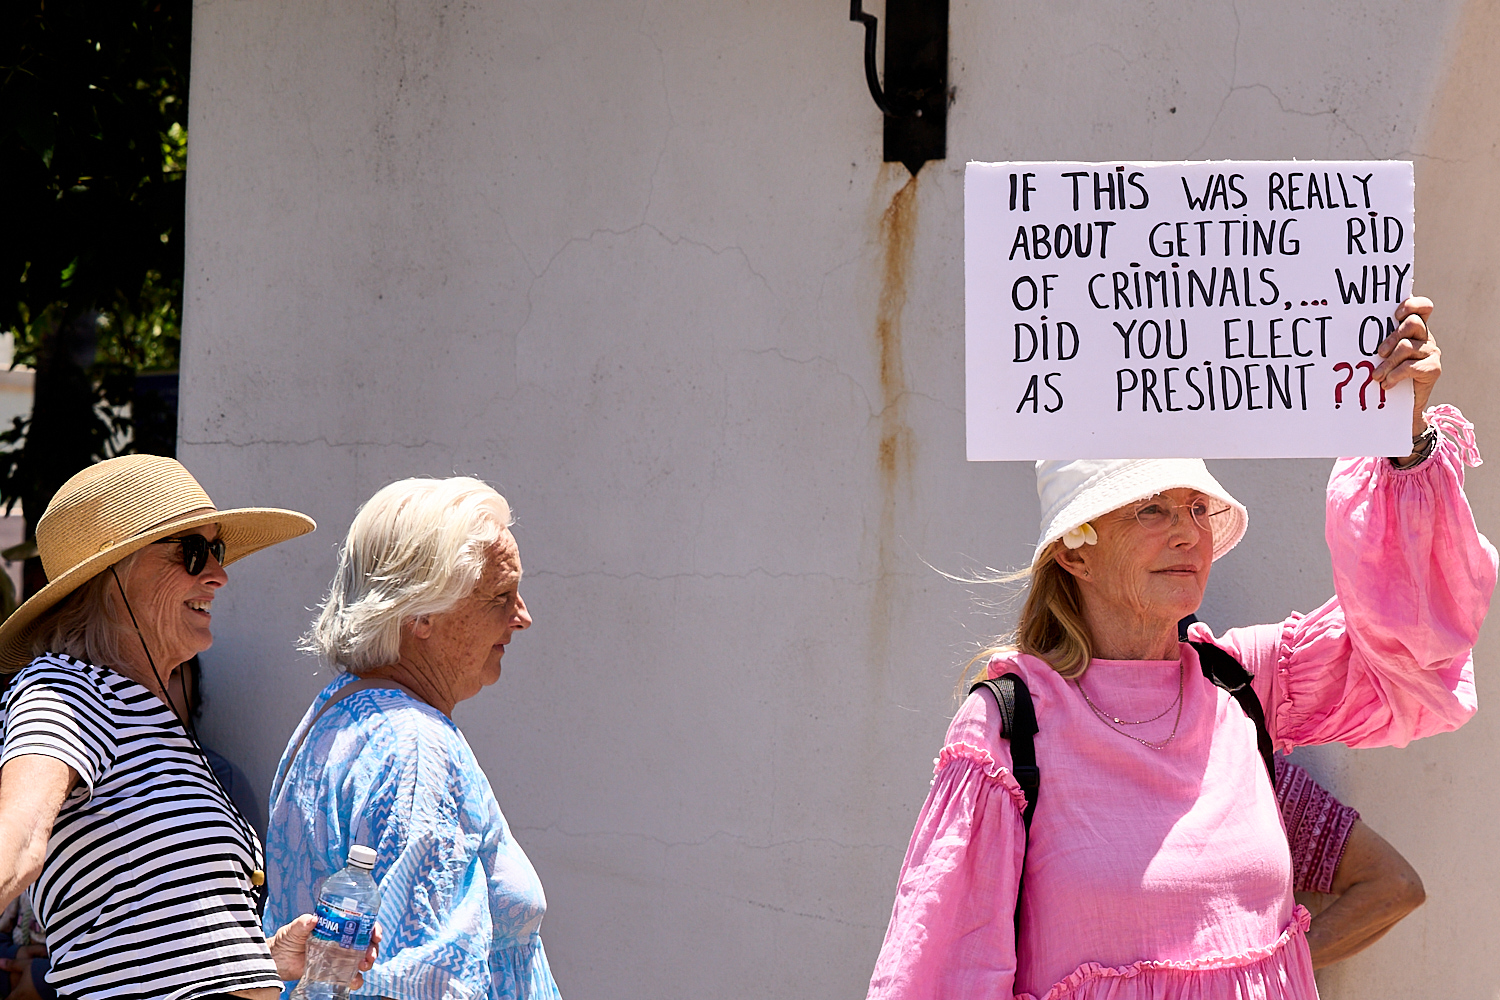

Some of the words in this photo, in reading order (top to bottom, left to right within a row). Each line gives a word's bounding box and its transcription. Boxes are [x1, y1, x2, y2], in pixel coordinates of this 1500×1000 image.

[1009, 172, 1037, 212] IF
[1181, 173, 1248, 212] WAS
[1268, 171, 1373, 212] REALLY
[1008, 221, 1117, 261] ABOUT
[1011, 274, 1059, 312] OF
[1112, 318, 1188, 360] YOU
[1223, 315, 1333, 360] ELECT
[1015, 372, 1064, 414] AS
